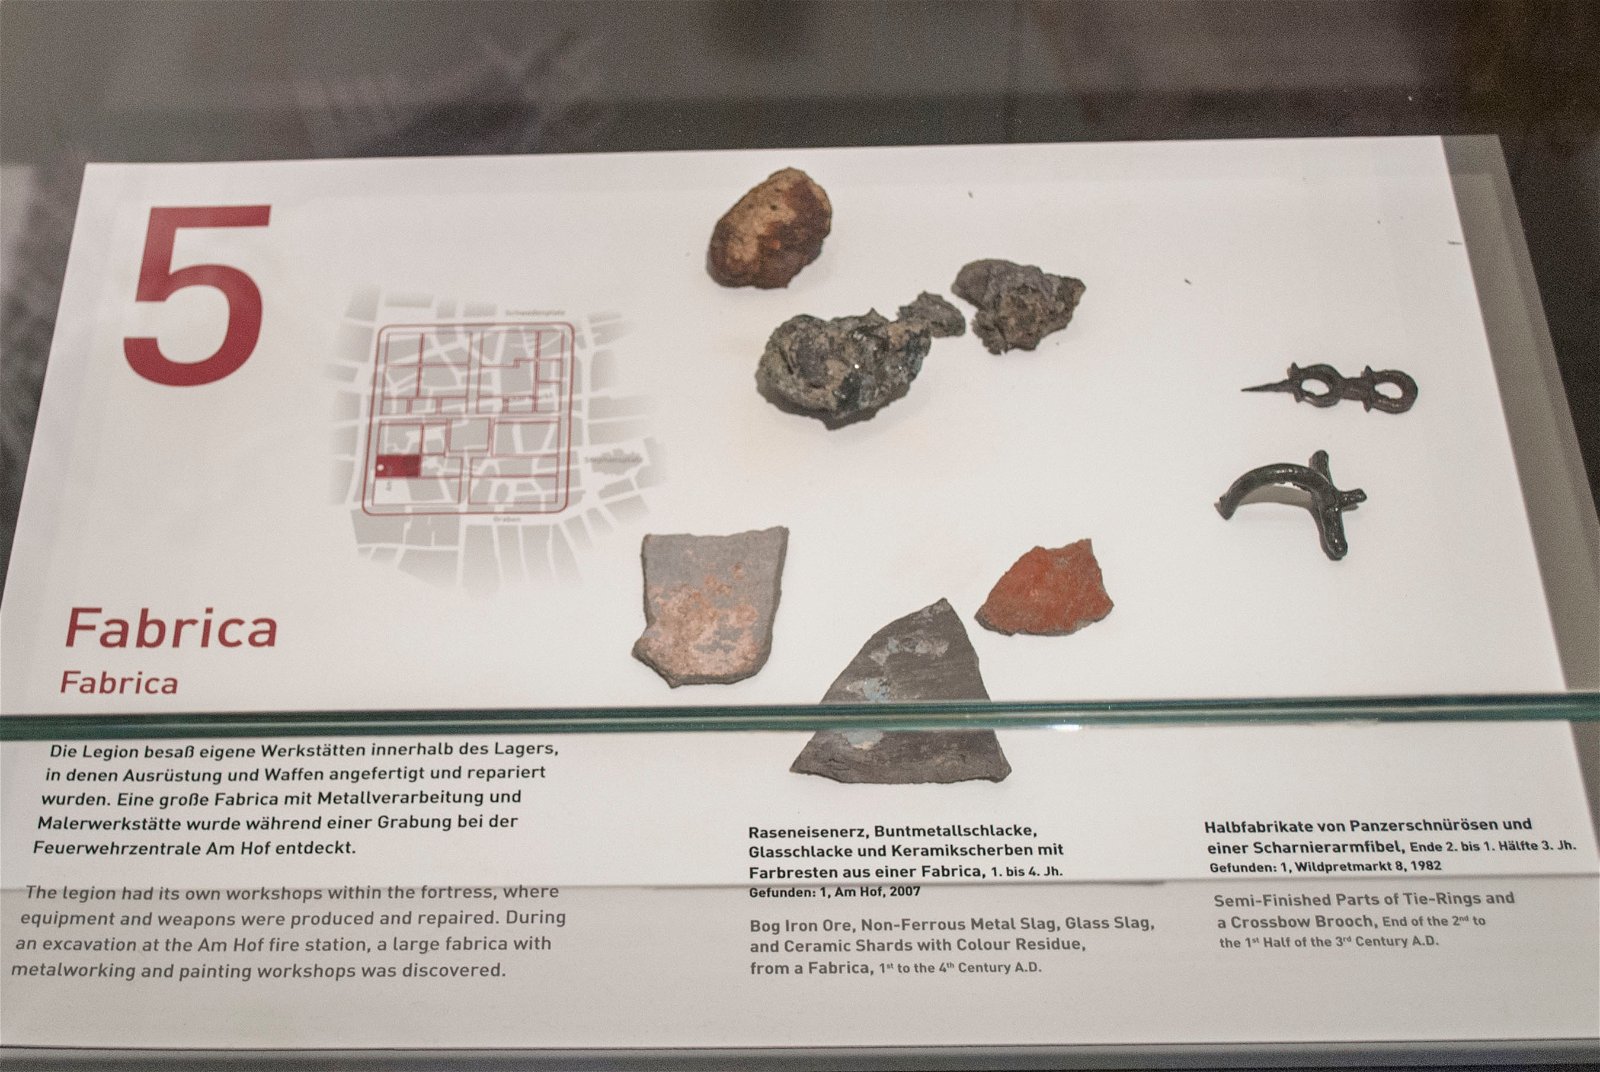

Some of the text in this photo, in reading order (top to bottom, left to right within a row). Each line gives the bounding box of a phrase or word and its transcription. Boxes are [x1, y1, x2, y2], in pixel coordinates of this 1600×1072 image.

[123, 204, 272, 388] 5
[65, 606, 277, 649] Fabrica
[60, 670, 178, 695] Fabrica
[50, 741, 559, 762] Die Legion besaß eigene Werkstätten innerhalb des Lagers,
[45, 765, 546, 786] in denen Ausrüstung und Waffen angefertigt und repariert
[41, 789, 522, 810] wurden. Eine große Fabrica mit Metallverarbeitung und
[37, 813, 519, 832] Malerwerkstätte wurde während einer Grabung bei der
[1204, 817, 1533, 834] Halbfabrikate von Panzerschnürösen und
[748, 824, 1038, 840] Raseneisenerz, Buntmetallschlacke,
[33, 840, 356, 856] Feuerwehrzentrale Am Hof entdeckt.
[748, 842, 1064, 859] Glasschlacke und Keramikscherben mit
[1207, 839, 1577, 855] einer Scharnierarmfibel, Ende 2. bis 1. Hälfte 3. Jh.
[749, 864, 1064, 880] Farbresten aus einer Fabrica, 1. bis 4. Jh.
[1209, 860, 1443, 874] Gefunden: 1, Wildpretmarkt 8, 1982
[26, 884, 560, 904] The legion had its own workshops within the fortress, where
[749, 884, 922, 899] Gefunden: 1, Am Hof, 2007
[1213, 891, 1516, 908] Semi-Finished Parts of Tie-Rings and
[20, 909, 566, 930] equipment and weapons were produced and repaired. During
[750, 915, 1155, 936] Bog Iron Ore, Non-Ferrous Metal Slag, Glass Slag,
[1217, 919, 1227, 929] a
[1230, 915, 1311, 929] Crossbow
[1314, 914, 1379, 929] Brooch,
[1381, 916, 1408, 928] End
[1410, 915, 1424, 927] of
[1426, 915, 1449, 927] the
[1472, 915, 1487, 926] to
[15, 935, 552, 955] an excavation at the Am Hof fire station, a large fabrica with
[750, 937, 1086, 953] and Ceramic Shards with Colour Residue,
[1219, 937, 1242, 949] the
[1262, 936, 1291, 948] Half
[1294, 936, 1307, 948] of
[1310, 936, 1333, 948] the
[1355, 935, 1409, 949] Century
[1411, 934, 1440, 946] A.D.
[11, 962, 506, 983] metalworking and painting workshops was discovered.
[750, 961, 790, 975] from
[794, 964, 804, 975] a
[808, 960, 875, 976] Fabrica,
[897, 963, 911, 974] to
[913, 962, 936, 974] the
[957, 961, 1012, 975] Century
[1014, 961, 1042, 973] A.D.
